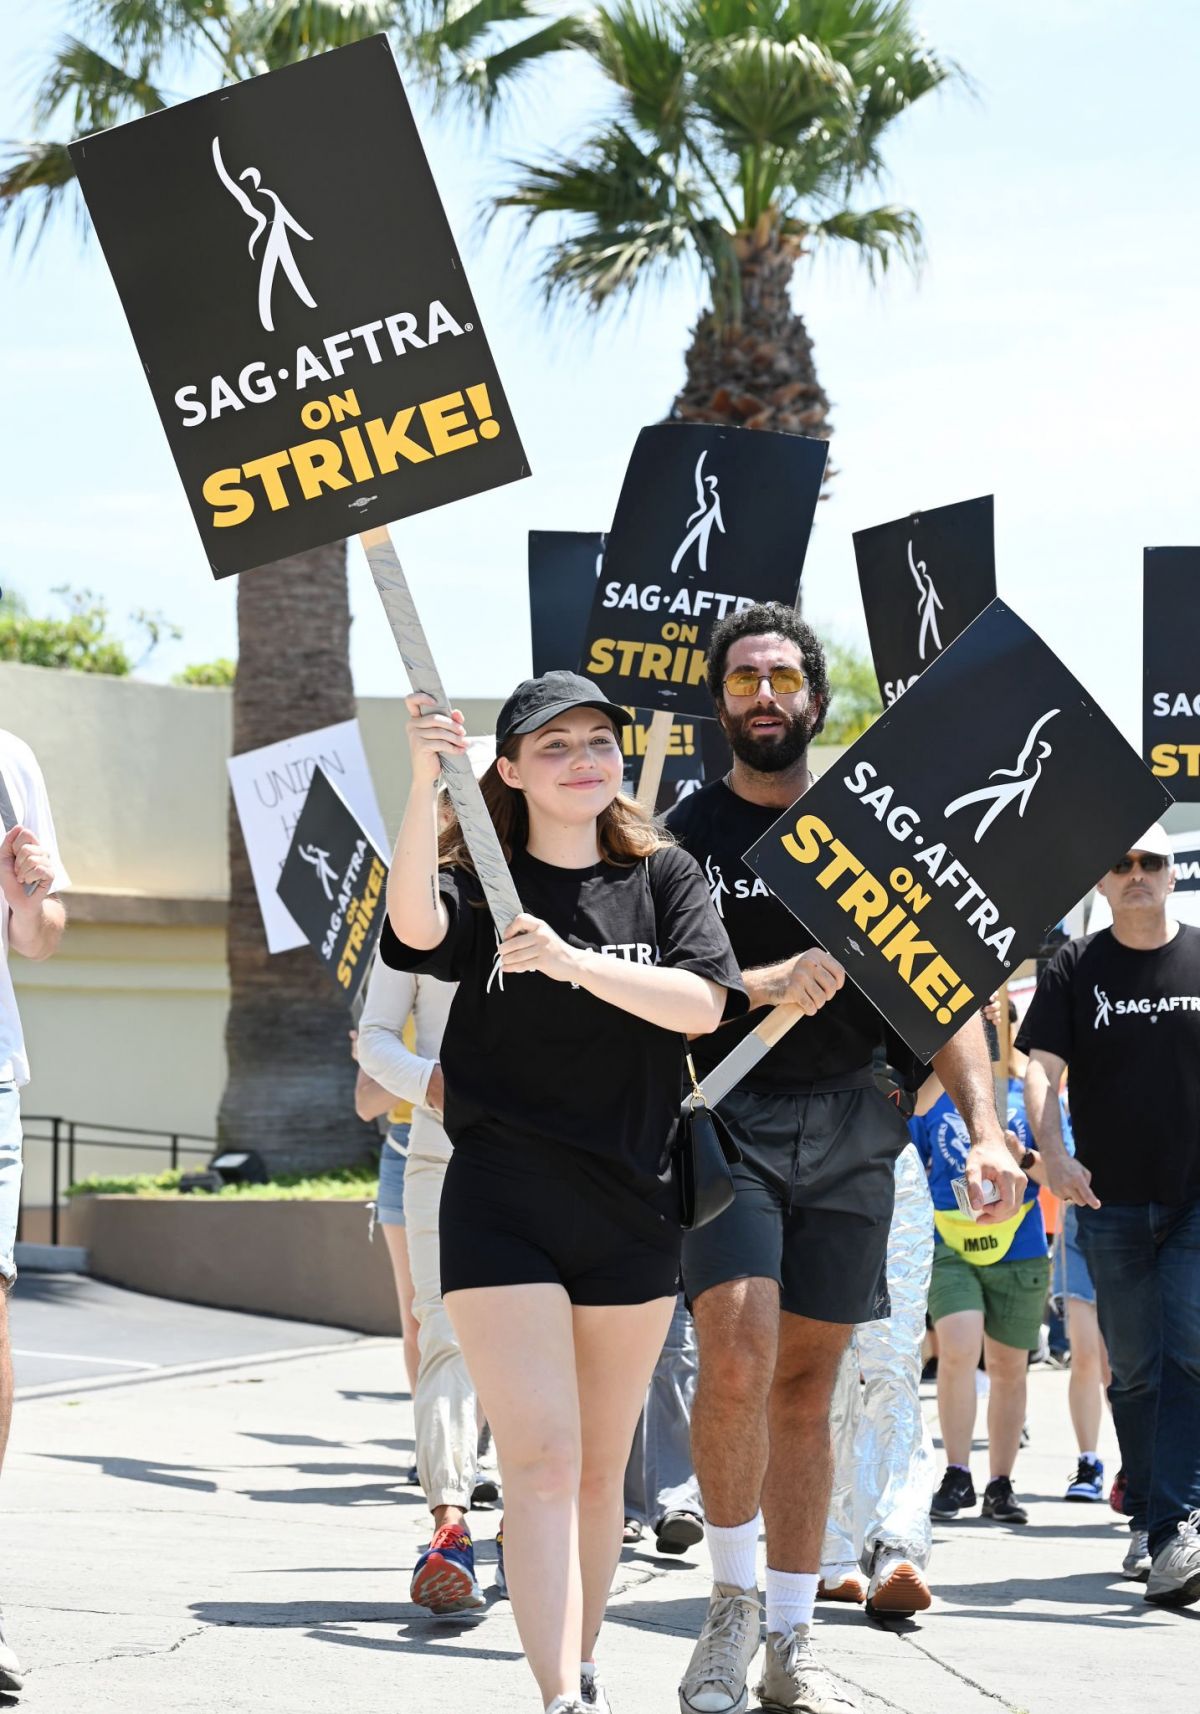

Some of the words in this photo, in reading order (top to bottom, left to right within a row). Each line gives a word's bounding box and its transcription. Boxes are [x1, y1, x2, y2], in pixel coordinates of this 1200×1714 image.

[300, 389, 361, 430] ON
[202, 383, 500, 528] STRIKE!
[661, 622, 698, 644] ON
[889, 866, 932, 914] ON
[337, 857, 386, 989] STRIKE!
[780, 814, 975, 1025] STRIKE!
[963, 1234, 998, 1252] IMDb
